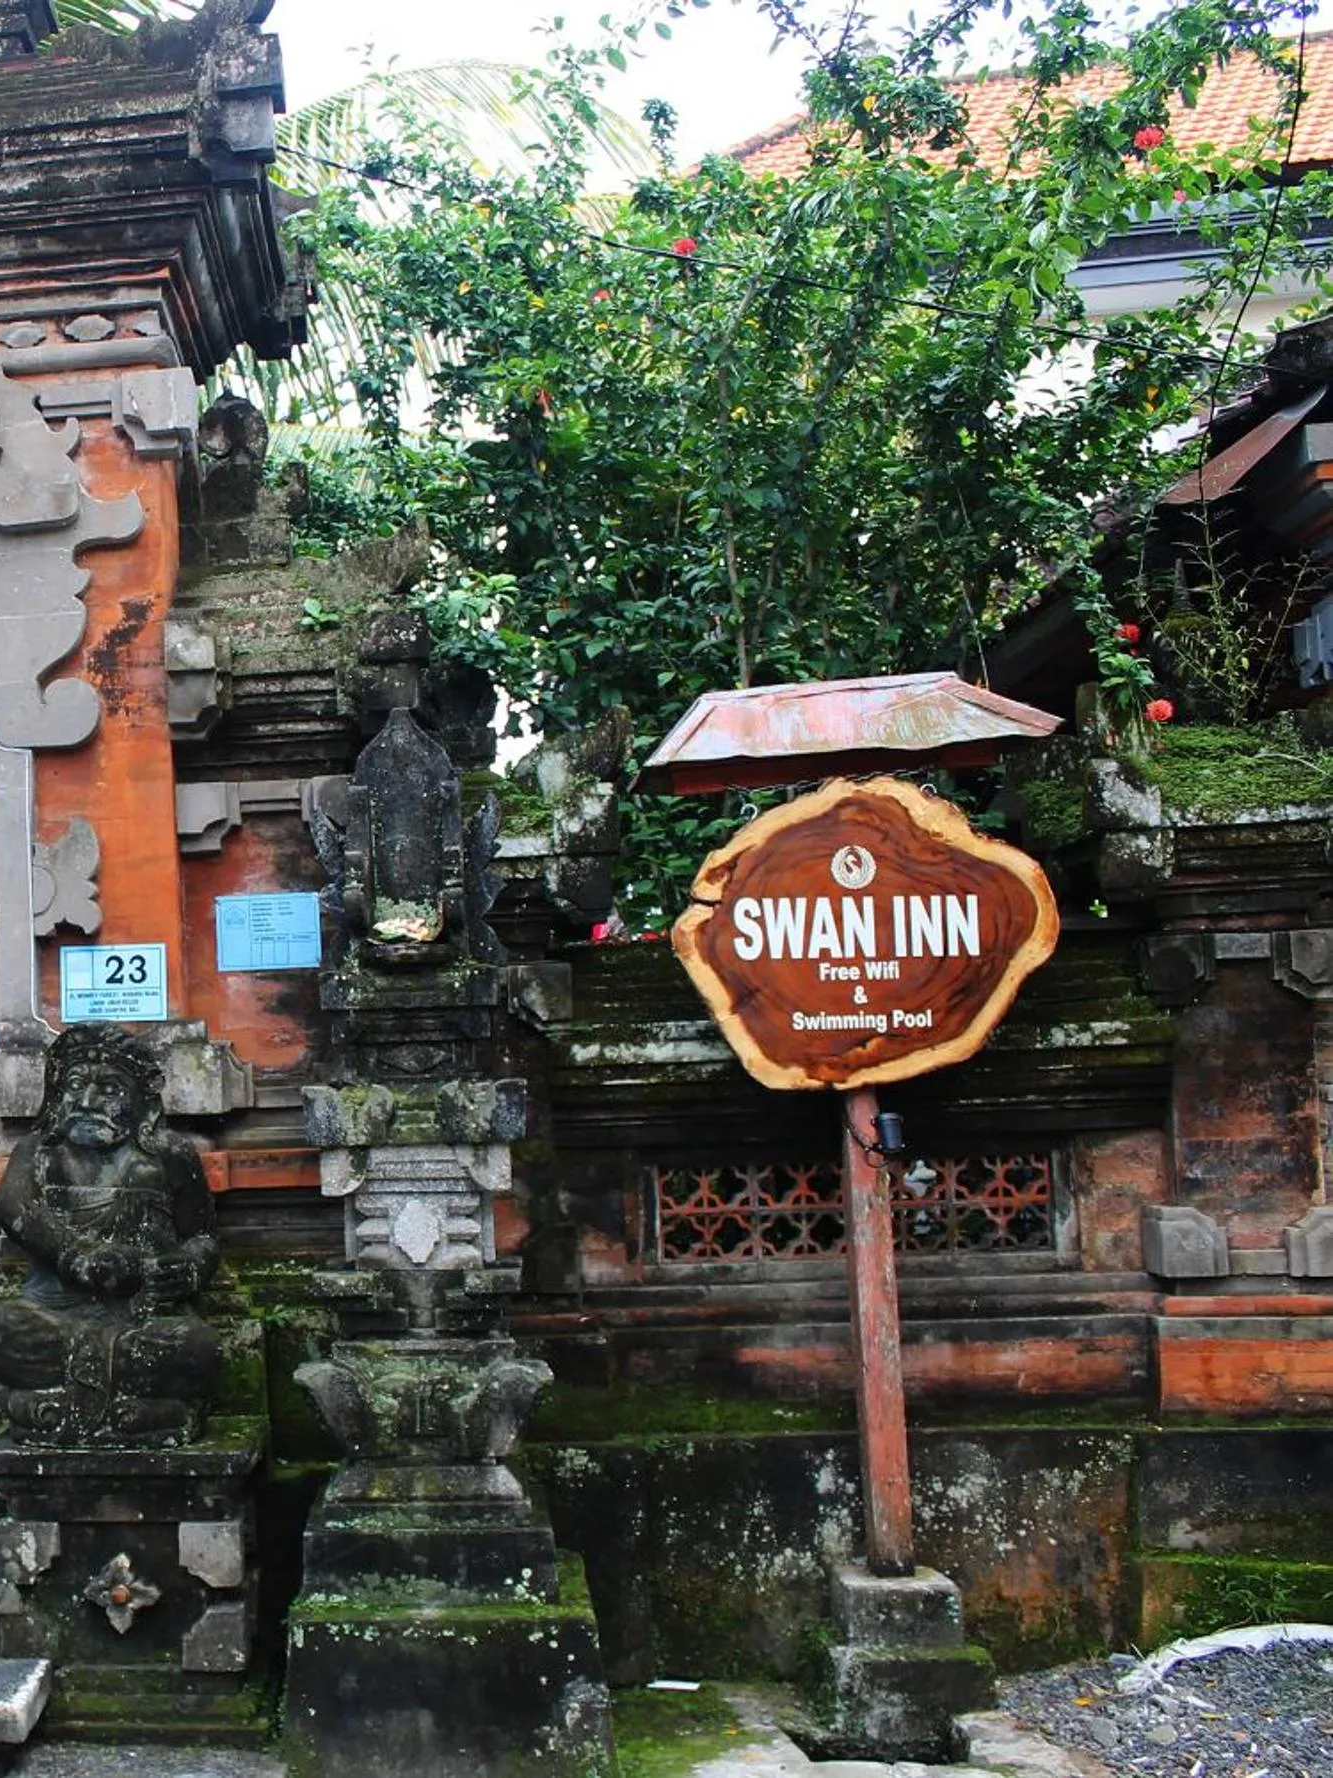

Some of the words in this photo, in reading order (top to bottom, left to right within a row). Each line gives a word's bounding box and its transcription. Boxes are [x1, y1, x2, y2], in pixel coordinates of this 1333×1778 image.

[733, 896, 876, 960] SWAN
[893, 895, 980, 957] INN
[105, 955, 147, 984] 23
[819, 962, 860, 981] Free
[865, 961, 900, 980] Wifi
[853, 985, 868, 1004] &
[792, 1011, 887, 1033] Swimming
[892, 1009, 932, 1028] Pool
